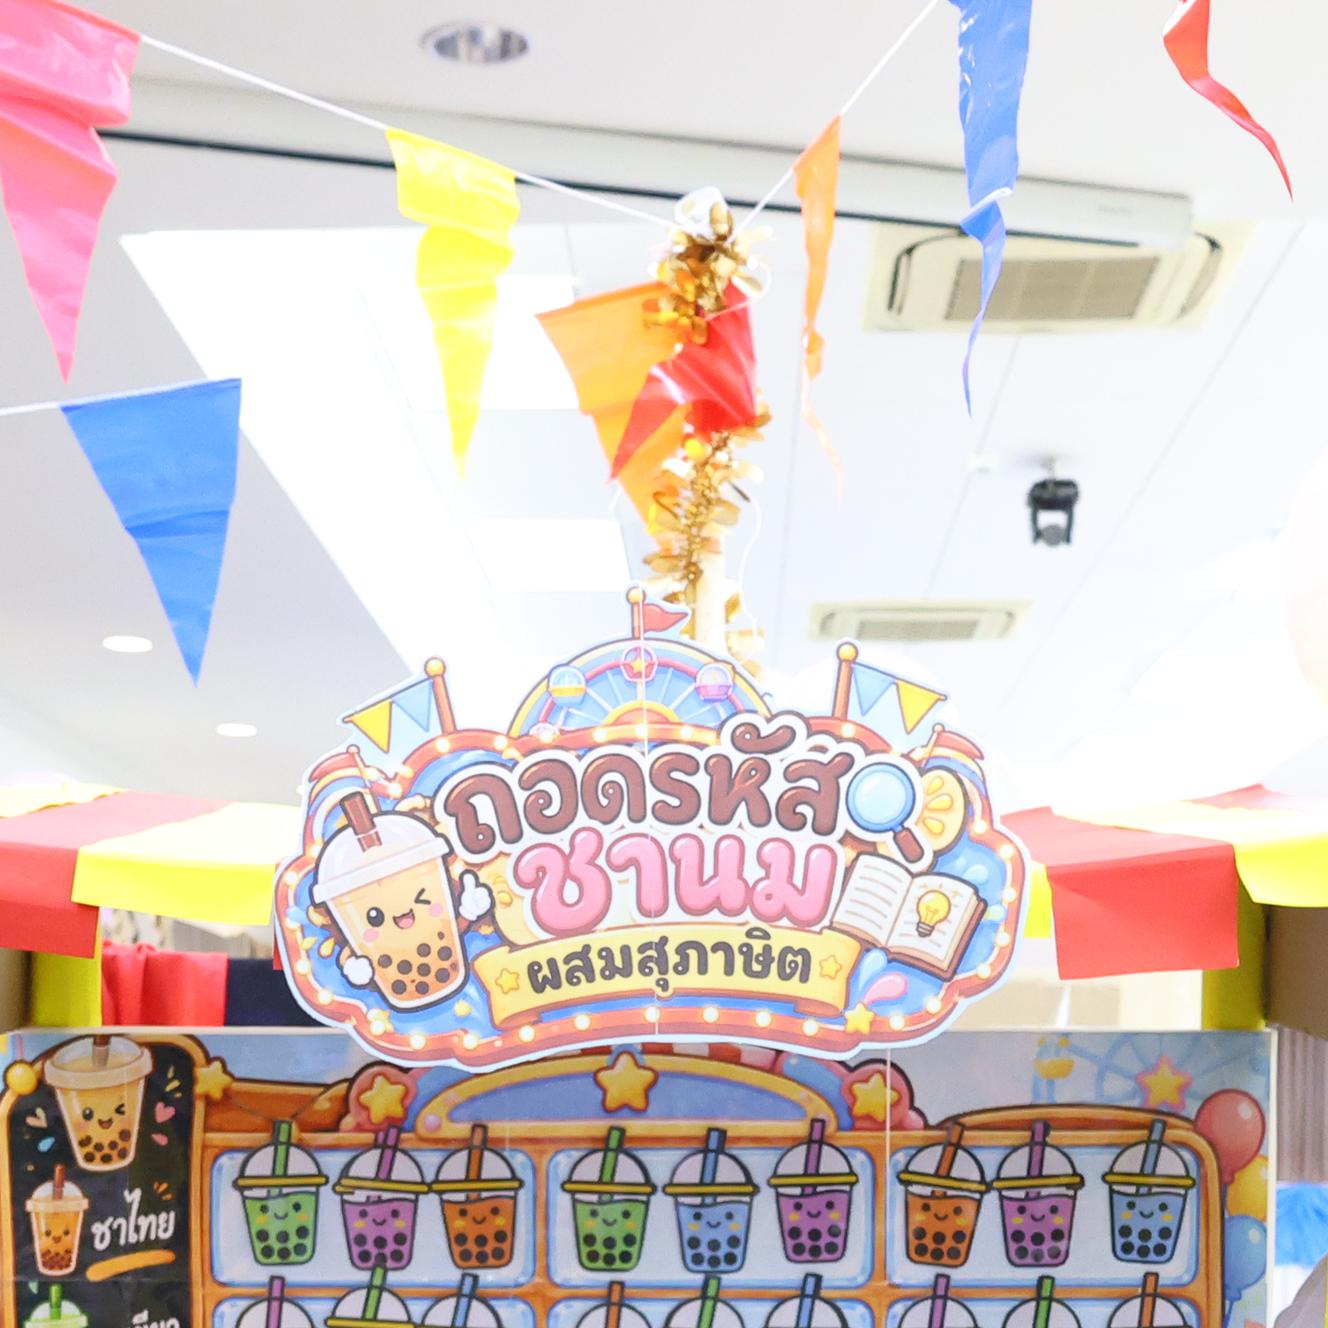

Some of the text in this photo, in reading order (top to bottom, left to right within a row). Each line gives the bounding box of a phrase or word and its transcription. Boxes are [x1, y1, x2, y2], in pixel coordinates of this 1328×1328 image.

[443, 721, 853, 855] ถอดรหัส
[513, 831, 837, 937] ชานม
[526, 927, 812, 993] ผสมสุภาษิต
[91, 1188, 175, 1250] ชาไทย
